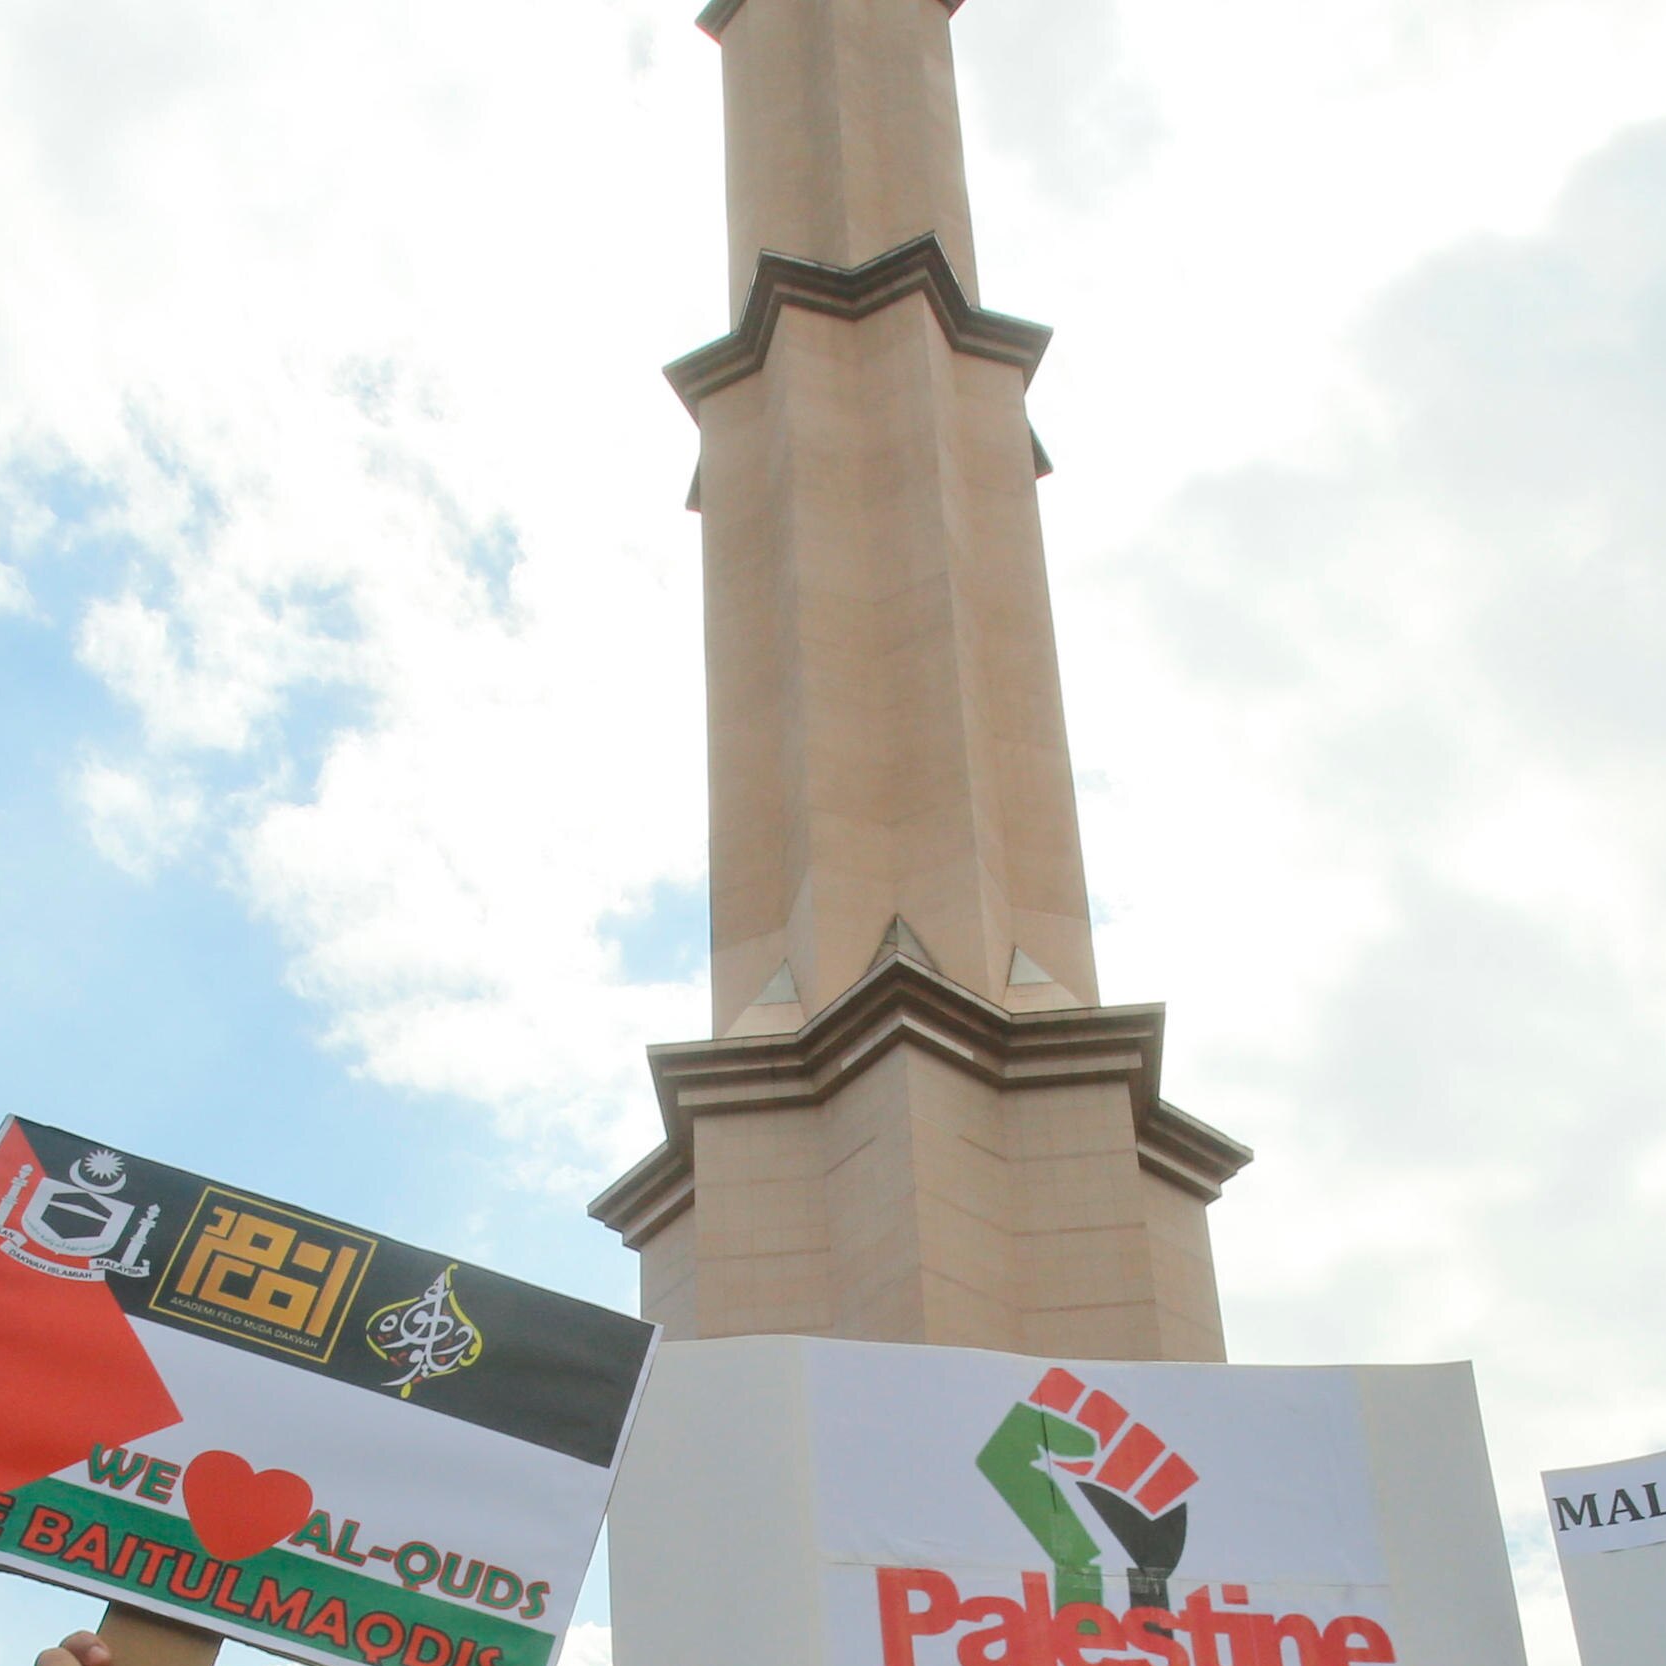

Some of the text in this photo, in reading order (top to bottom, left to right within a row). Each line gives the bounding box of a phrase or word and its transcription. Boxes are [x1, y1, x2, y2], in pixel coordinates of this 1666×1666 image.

[170, 1296, 319, 1350] AKADEMI FELO MUDA DAKWAH
[87, 1443, 556, 1619] WE AL-QUDS
